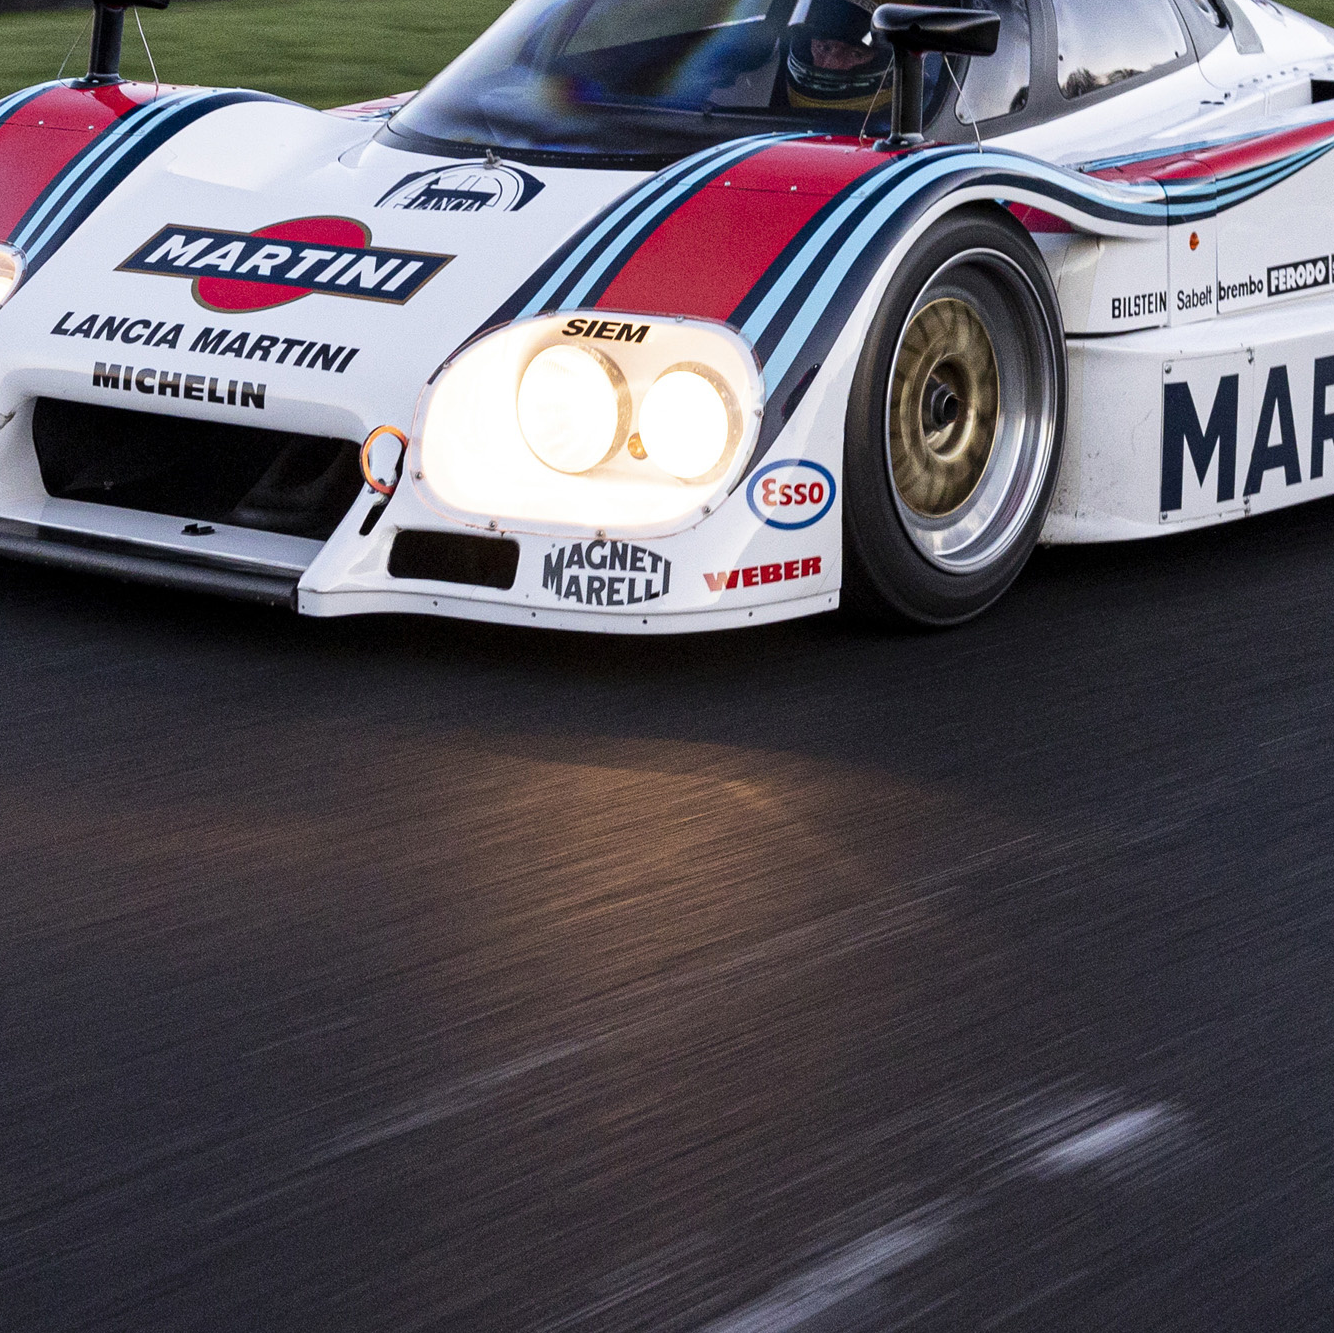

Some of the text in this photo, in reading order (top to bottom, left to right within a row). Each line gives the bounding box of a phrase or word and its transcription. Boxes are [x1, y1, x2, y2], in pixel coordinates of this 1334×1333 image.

[409, 195, 482, 212] LANCIA
[144, 233, 425, 292] MARTINI
[1111, 291, 1167, 319] BILSTEIN
[1176, 285, 1213, 311] Sabelt
[1218, 274, 1264, 301] brembo
[1269, 258, 1327, 294] FERODO
[50, 311, 363, 374] LANCIA MARTINI
[561, 318, 650, 343] SIEM
[91, 361, 267, 410] MICHELIN
[542, 539, 672, 581] MAGNETI
[703, 555, 822, 592] WEBER
[542, 566, 672, 606] MARELLI
